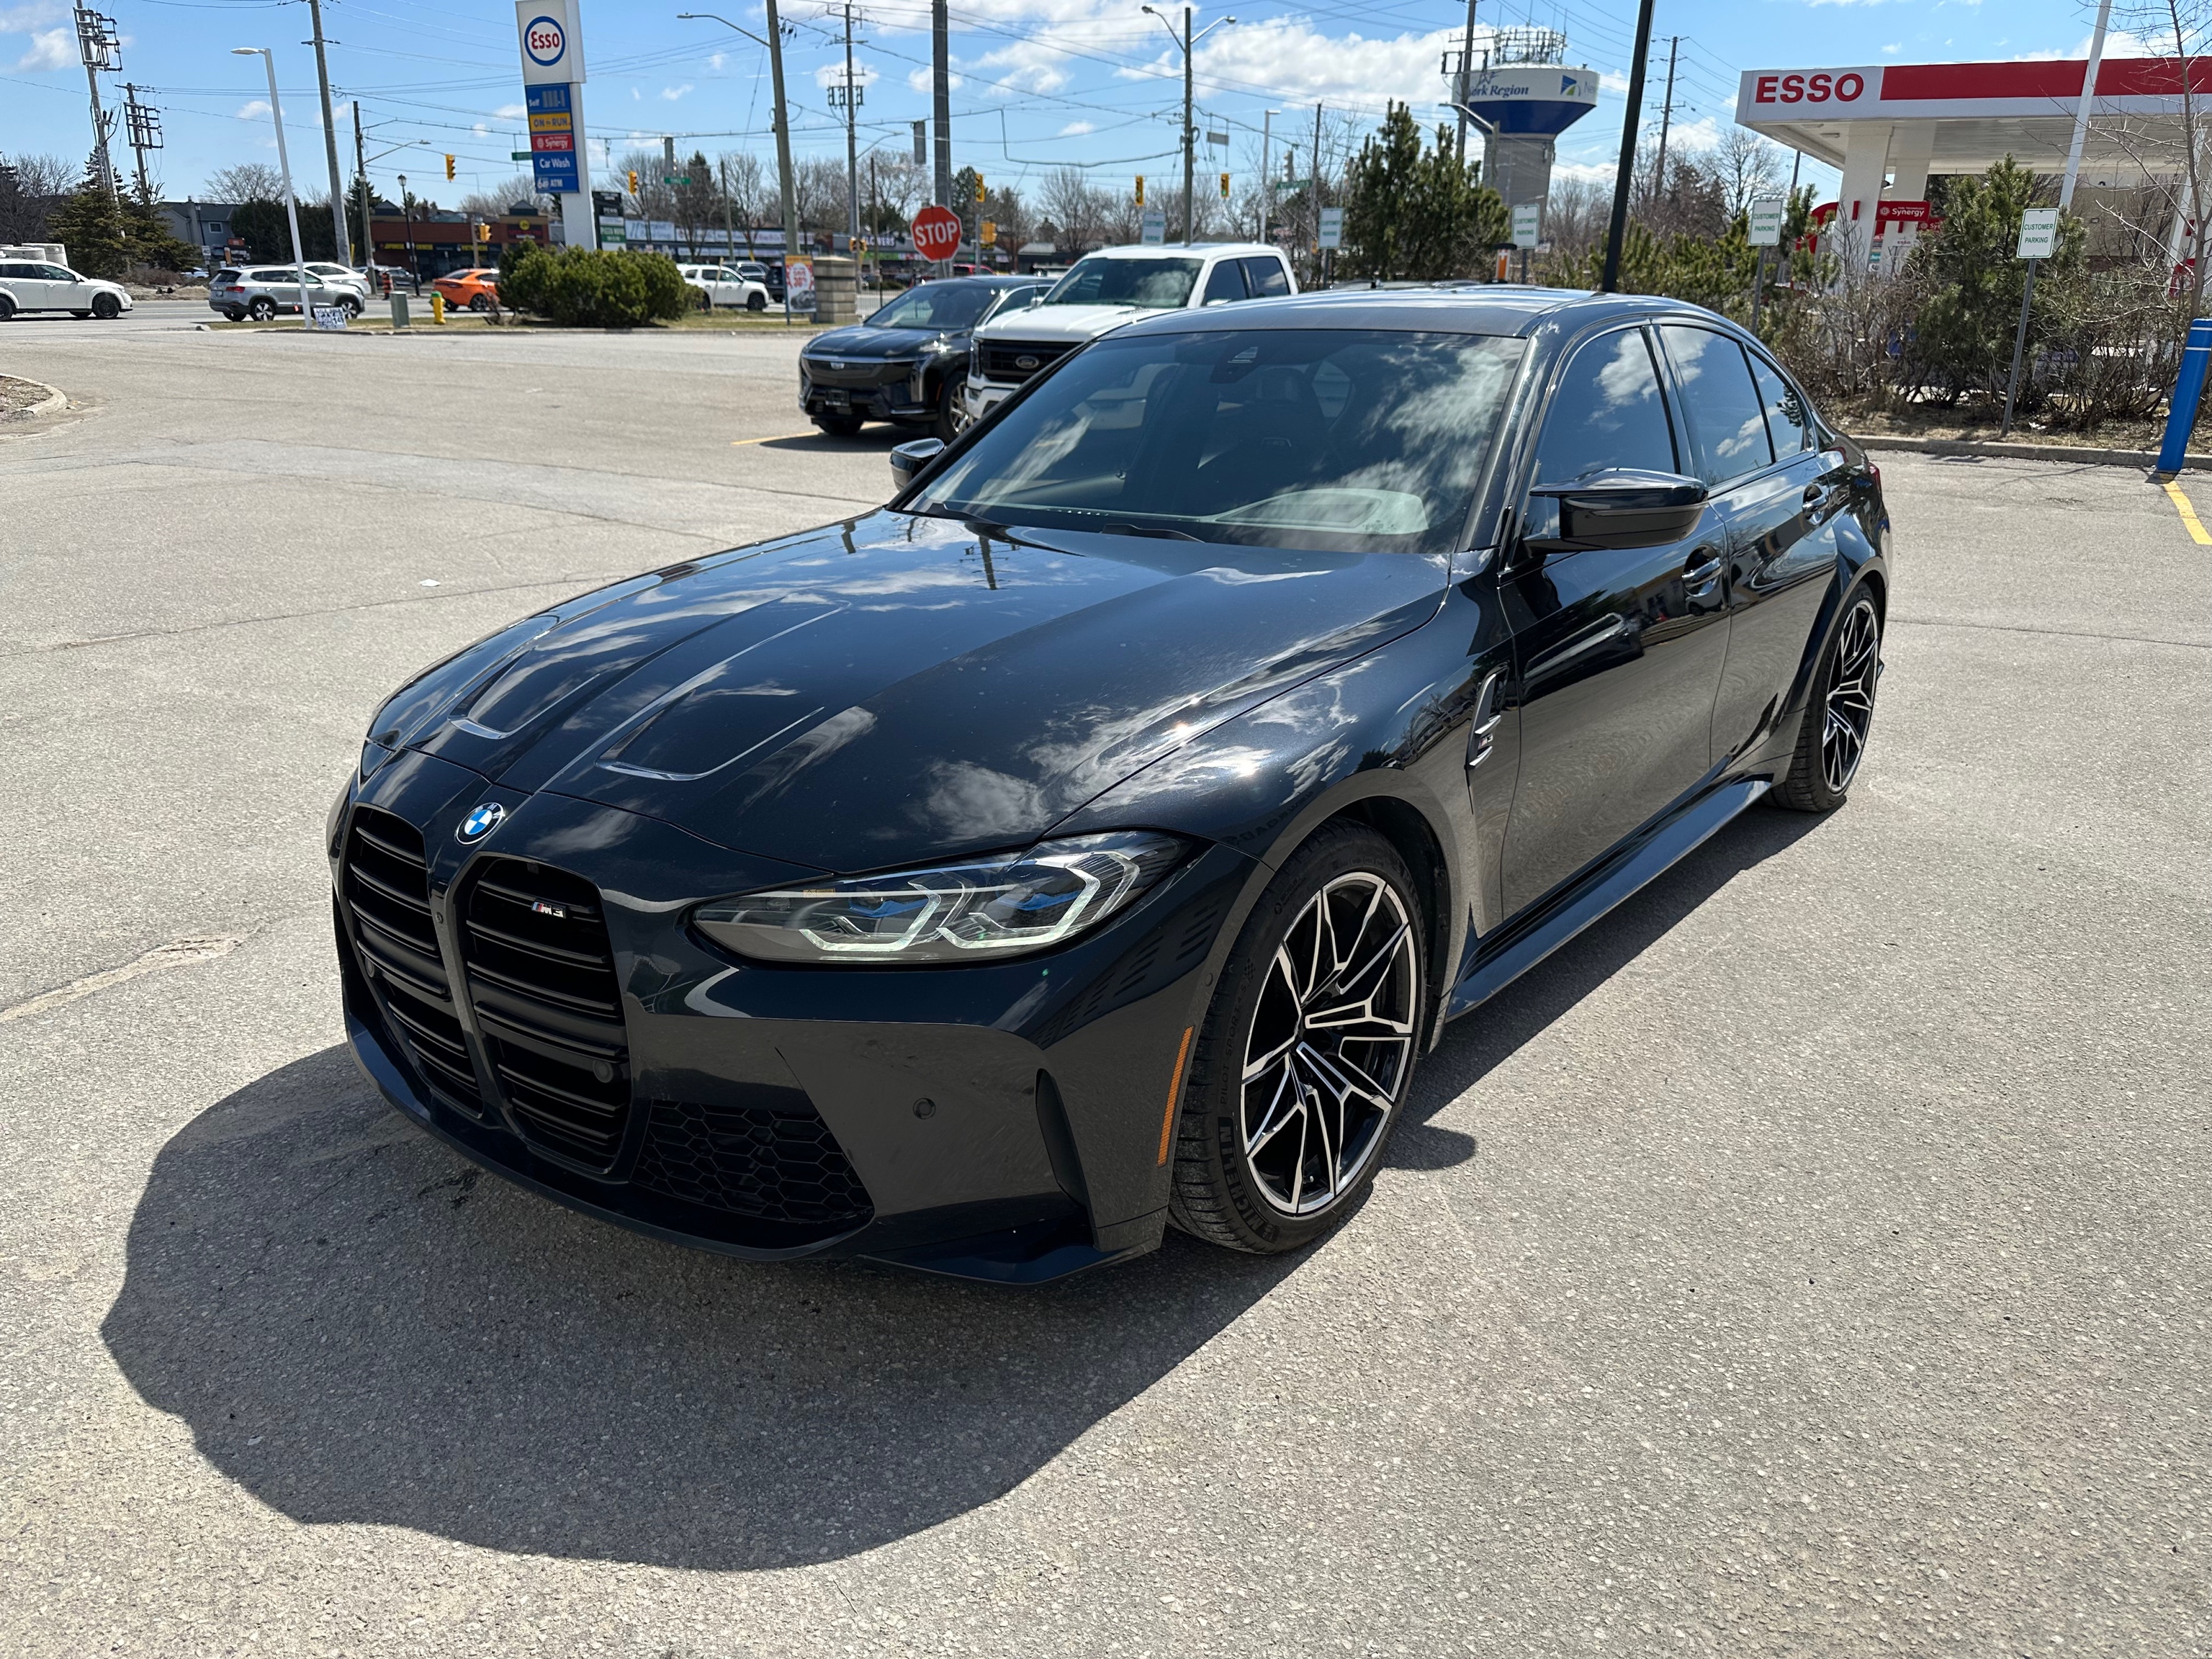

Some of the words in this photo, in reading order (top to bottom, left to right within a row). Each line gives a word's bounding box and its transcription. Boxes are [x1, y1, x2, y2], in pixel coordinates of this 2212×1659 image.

[531, 31, 560, 50] Esso
[1470, 84, 1488, 96] ork
[1490, 84, 1529, 98] Region
[1755, 73, 1864, 104] ESSO
[534, 119, 545, 127] ON
[552, 117, 567, 127] RUN
[545, 138, 568, 149] Synergy
[539, 158, 551, 168] Car
[551, 156, 570, 168] Wash
[1892, 207, 1925, 217] Synergy
[914, 221, 958, 247] STOP
[1225, 1005, 1241, 1056] SPORT
[1220, 1065, 1231, 1105] PILOT
[1219, 1125, 1265, 1233] MICHELIN
